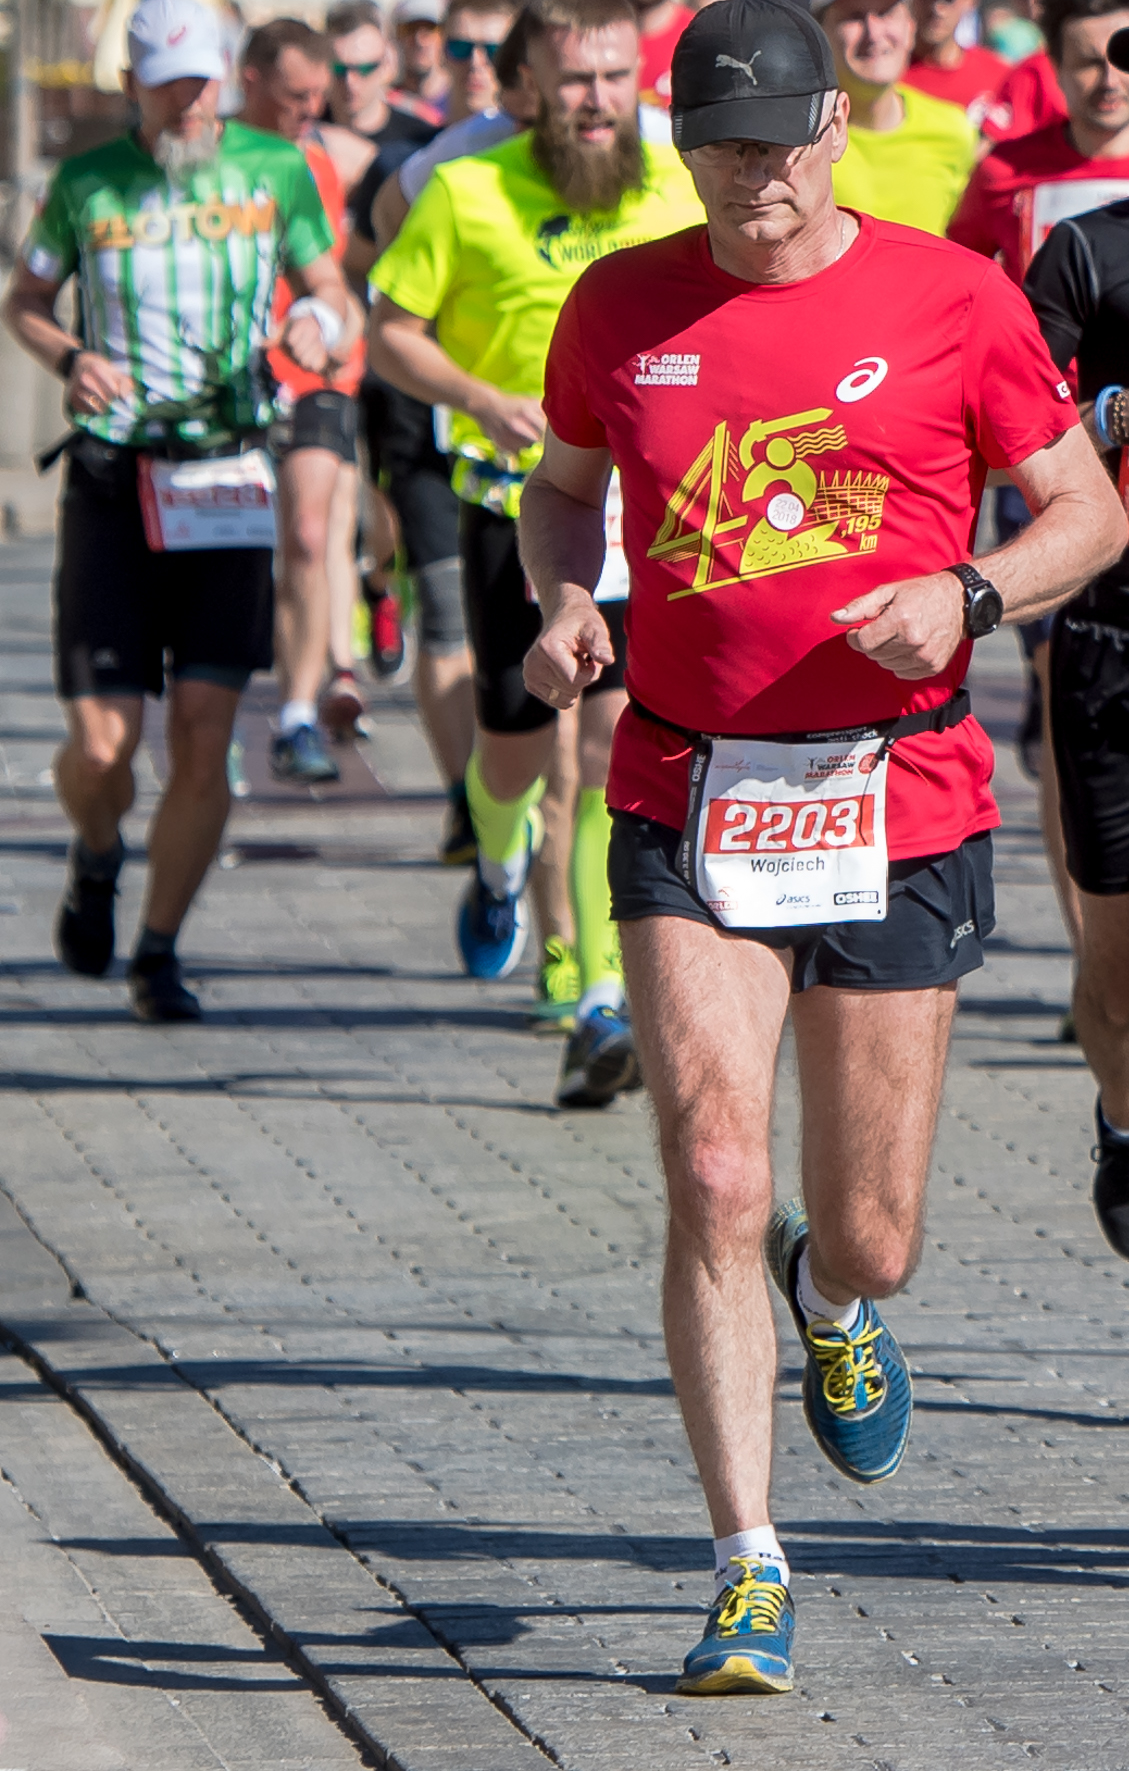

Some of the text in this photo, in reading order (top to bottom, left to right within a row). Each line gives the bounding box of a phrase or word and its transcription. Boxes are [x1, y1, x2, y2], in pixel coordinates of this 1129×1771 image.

[661, 354, 701, 365] ORLEN
[649, 364, 700, 374] WARSAW
[634, 374, 698, 385] MARATHON
[772, 509, 798, 525] 2018
[859, 533, 878, 551] km
[719, 799, 859, 851] 2203
[751, 855, 825, 877] Wojciech
